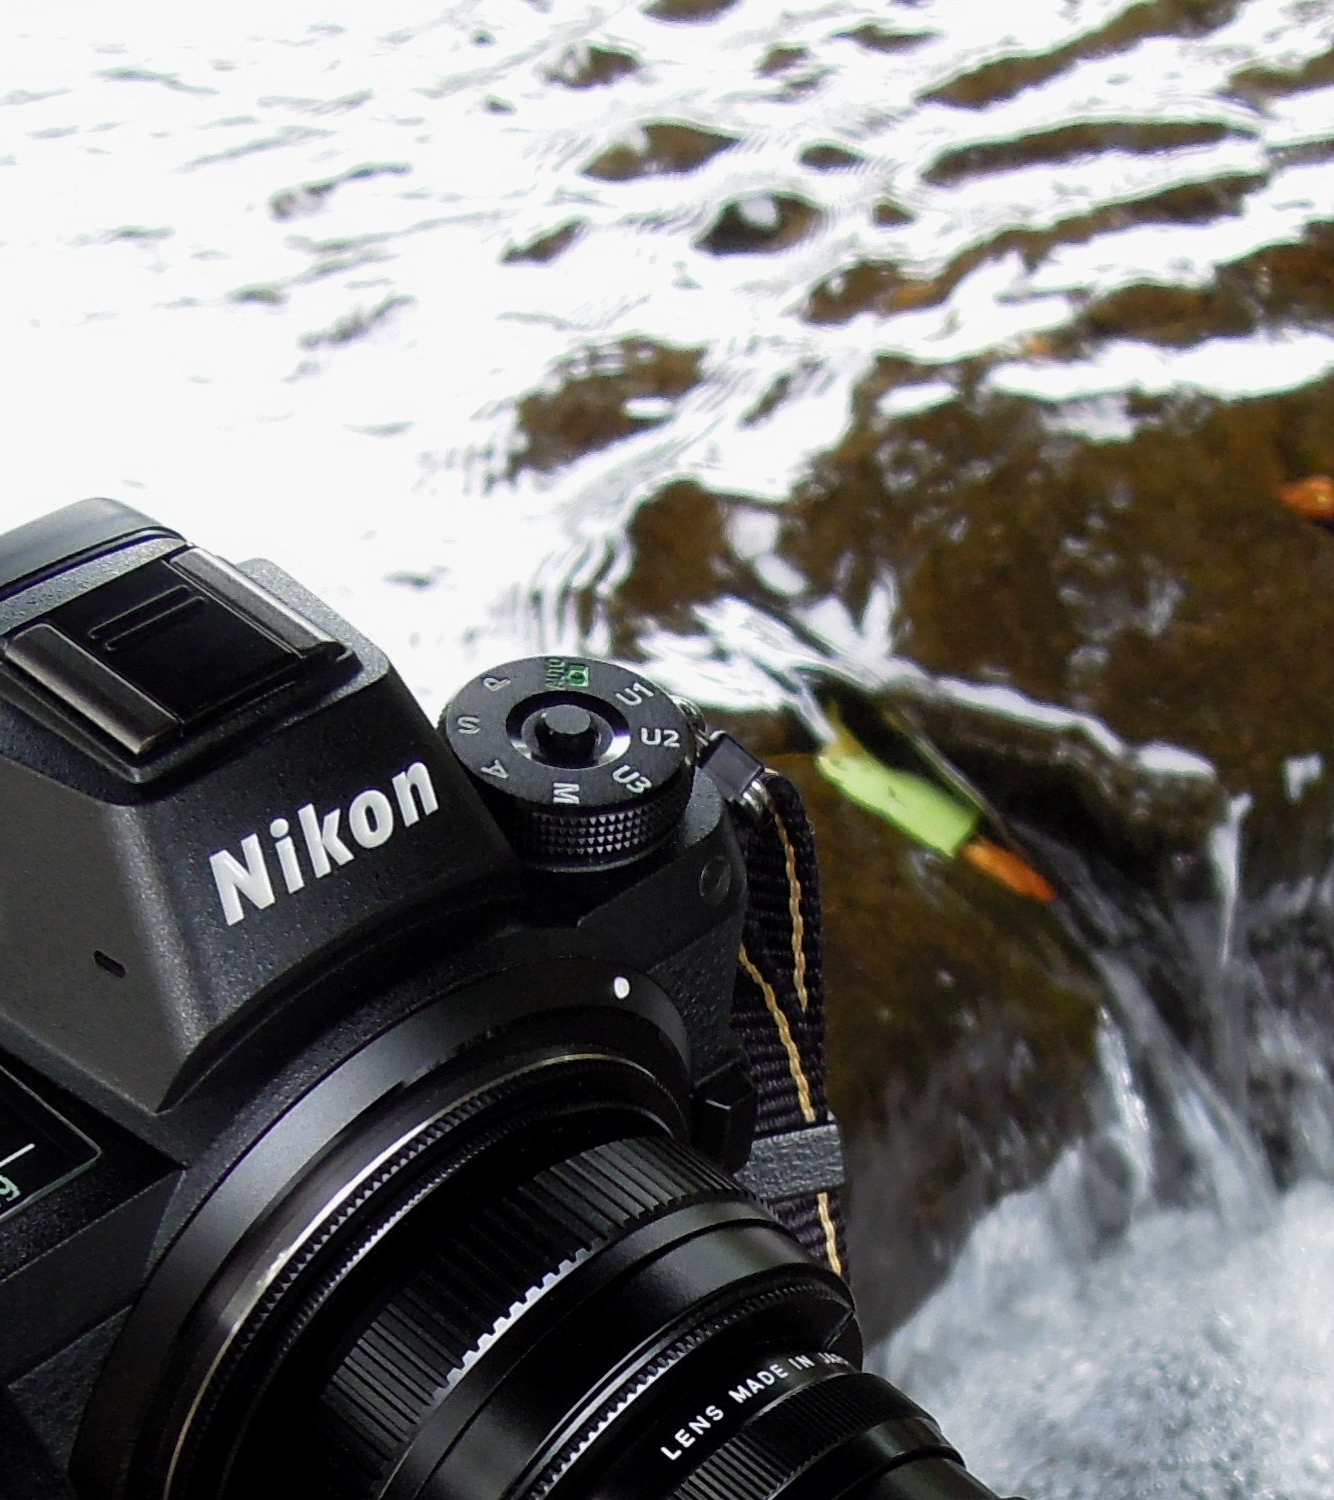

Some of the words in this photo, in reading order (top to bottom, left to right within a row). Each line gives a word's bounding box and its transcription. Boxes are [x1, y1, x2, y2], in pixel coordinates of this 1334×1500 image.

[483, 677, 511, 692] P
[616, 682, 655, 707] U1
[457, 716, 481, 735] S
[640, 727, 680, 748] U2
[480, 759, 510, 780] A
[611, 764, 653, 795] U3
[553, 782, 580, 805] M
[208, 761, 439, 926] Nikon
[660, 1404, 725, 1461] LENS
[727, 1363, 789, 1404] MADE
[787, 1354, 816, 1371] IN
